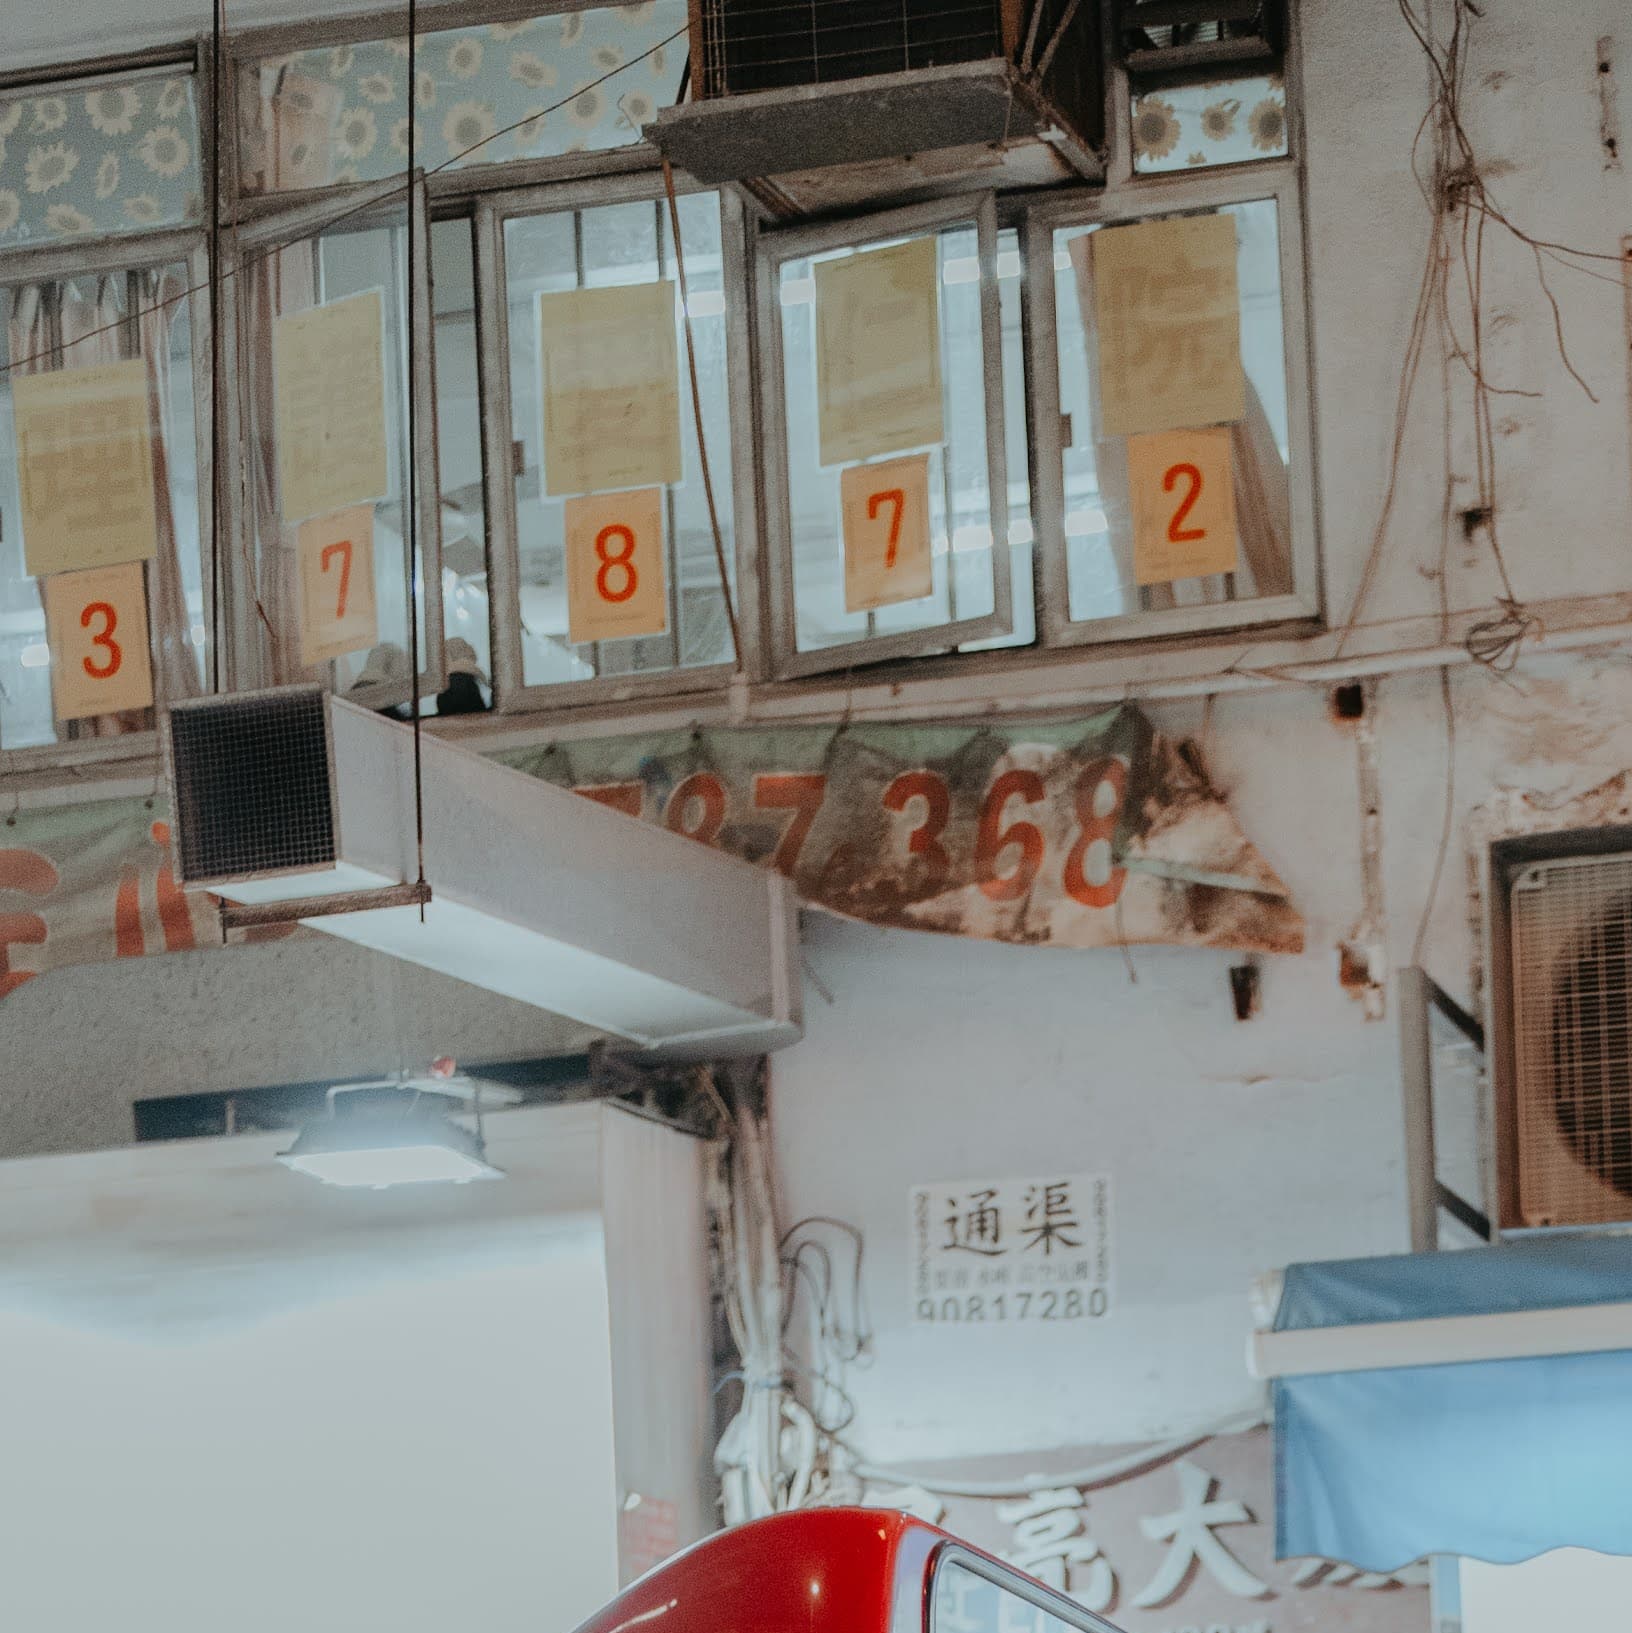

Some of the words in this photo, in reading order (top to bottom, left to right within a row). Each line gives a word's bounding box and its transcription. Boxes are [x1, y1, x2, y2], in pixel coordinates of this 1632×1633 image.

[868, 489, 905, 569] 7
[1163, 463, 1205, 543] 2
[320, 540, 354, 619] 7
[595, 523, 639, 603] 8
[80, 601, 122, 680] 3
[942, 1181, 1083, 1256] 通渠
